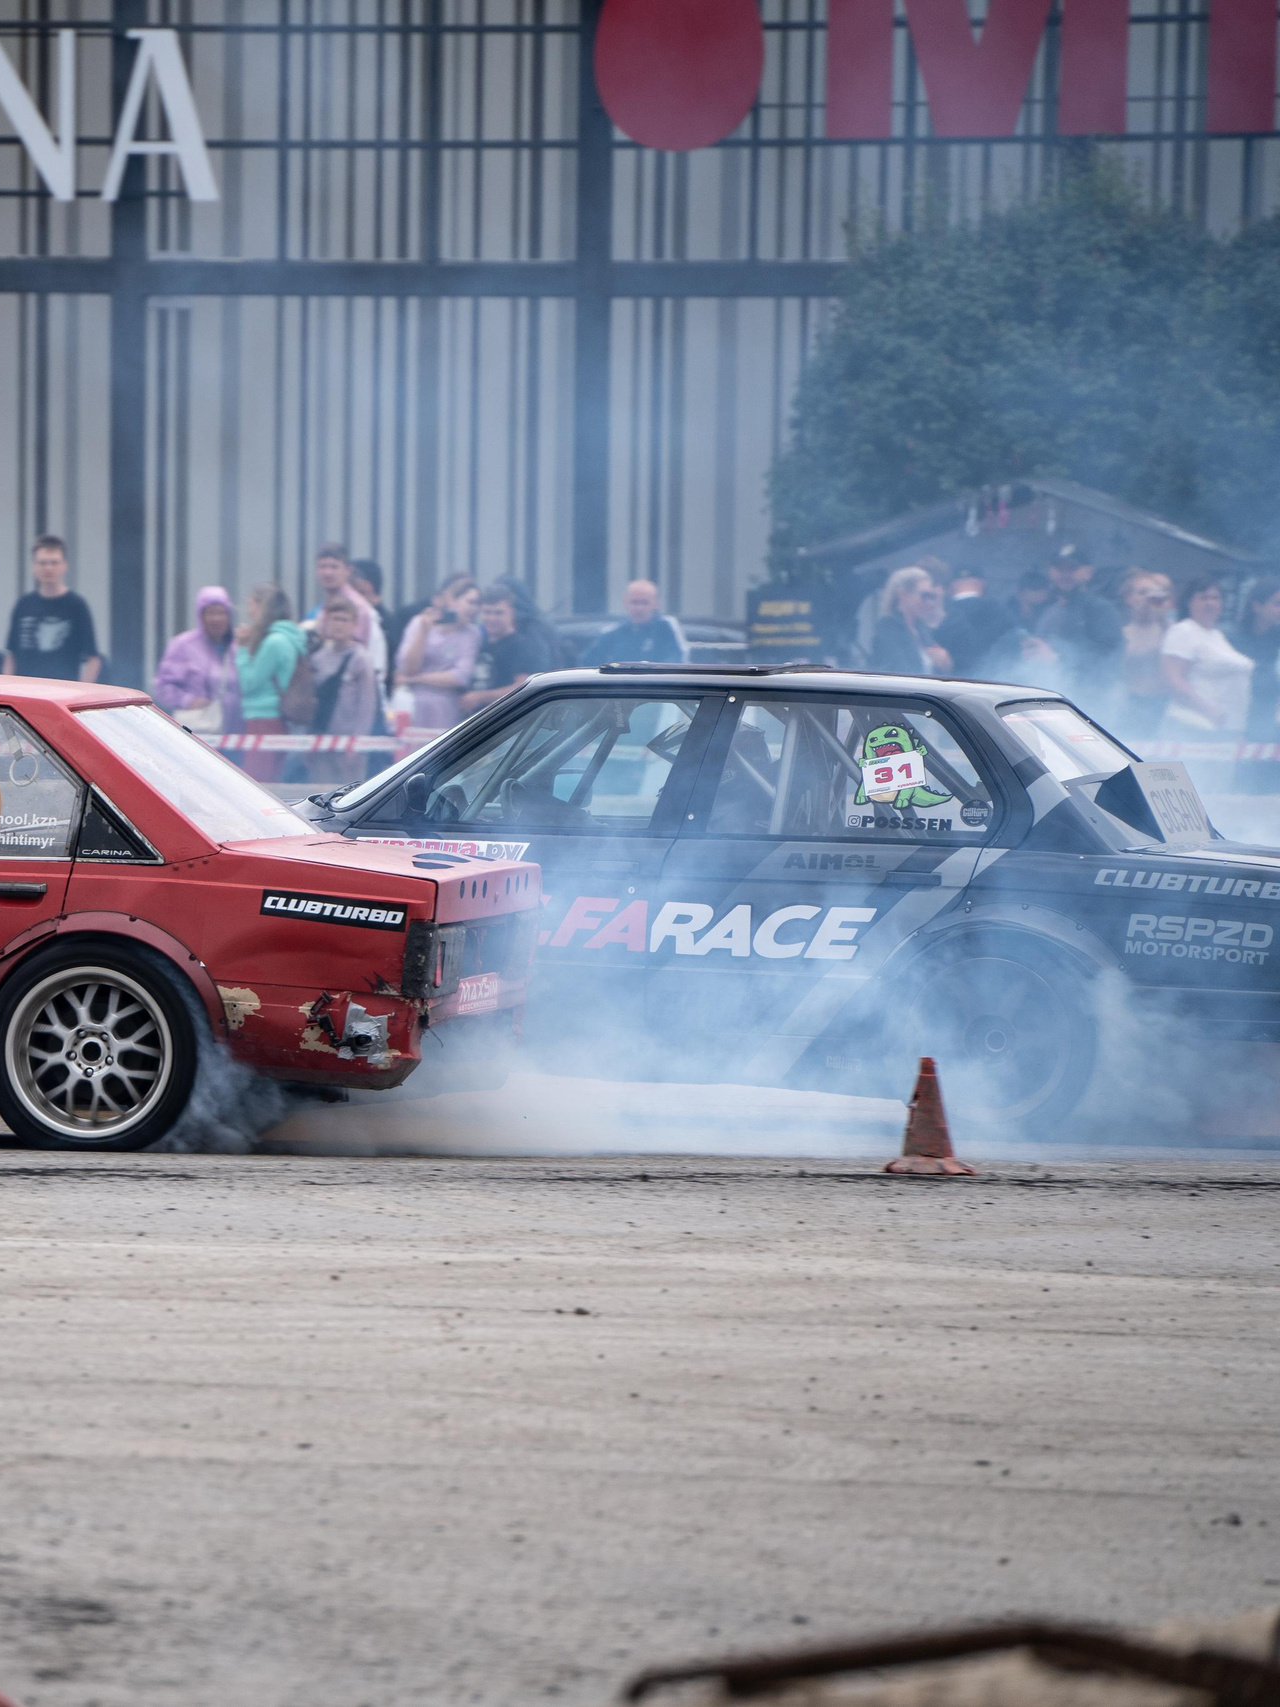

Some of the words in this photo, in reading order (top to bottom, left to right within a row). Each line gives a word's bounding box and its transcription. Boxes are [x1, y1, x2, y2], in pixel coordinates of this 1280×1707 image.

[874, 763, 912, 784] 31
[861, 816, 953, 832] POSSSEN
[81, 848, 132, 857] CARINA
[783, 853, 880, 871] AIMOL
[263, 896, 405, 925] CLUBTURBO
[1127, 913, 1274, 949] RSPZD
[1124, 940, 1270, 965] MOTORSPORT
